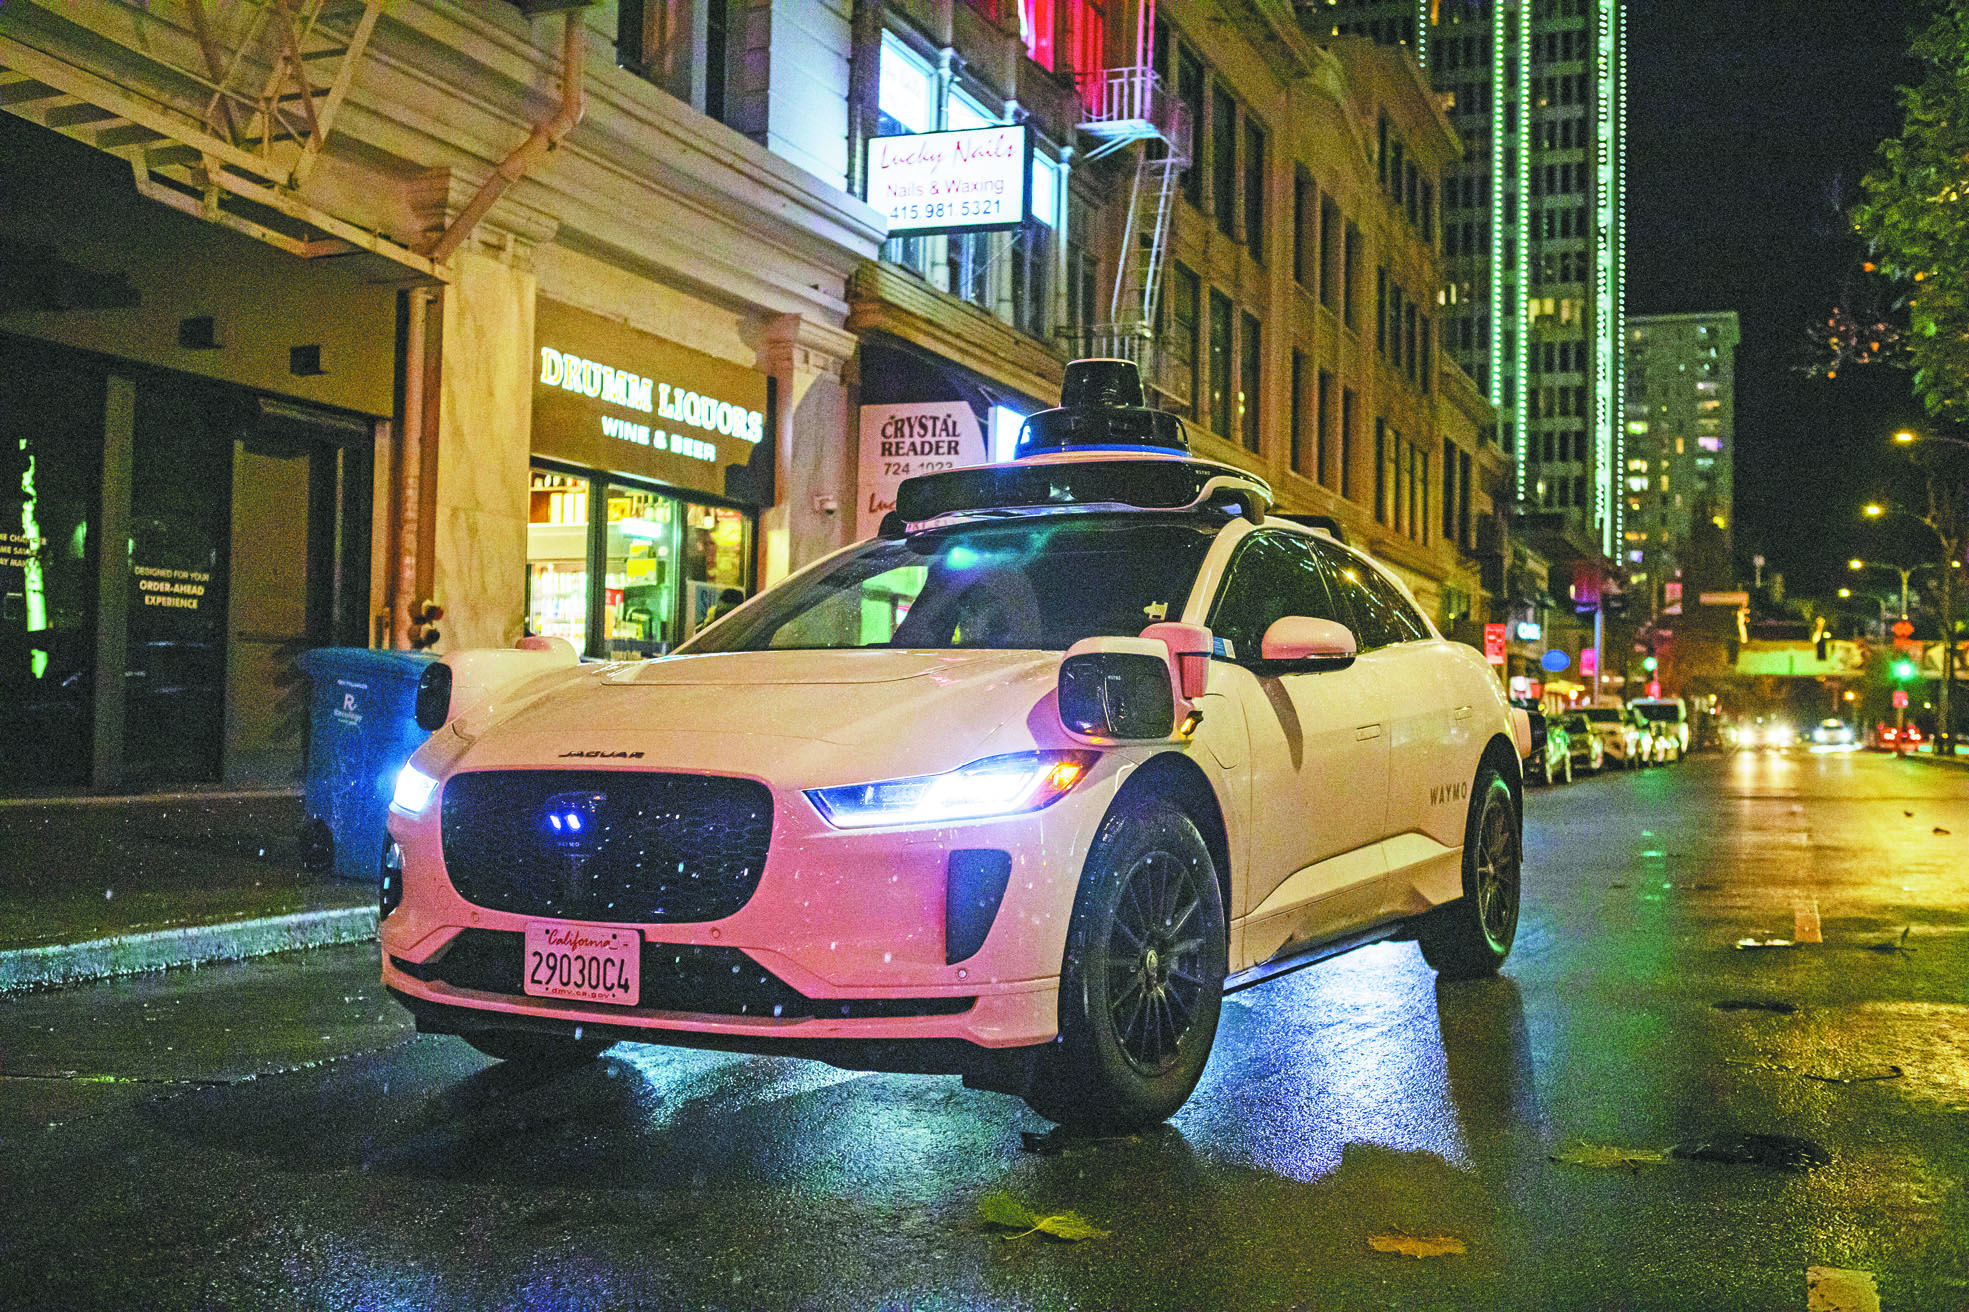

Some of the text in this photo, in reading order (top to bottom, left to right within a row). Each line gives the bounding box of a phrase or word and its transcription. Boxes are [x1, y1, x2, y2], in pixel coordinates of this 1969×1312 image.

[881, 133, 1014, 174] Lucky Nails
[887, 178, 1005, 197] Nails & Waxing
[541, 346, 763, 443] DRUMM LIQUORS
[881, 414, 961, 439] CRYSTAL
[601, 415, 717, 462] WINE & BEER
[880, 439, 960, 457] READER
[884, 462, 910, 476] 724
[134, 566, 210, 582] DESIGNED FOR YOUR
[139, 580, 205, 596] ORDER-AHEAD
[144, 594, 199, 610] EXPERIENCE
[558, 750, 645, 758] JAGUAR
[1430, 781, 1468, 806] WAYMO
[548, 928, 612, 952] California
[530, 950, 630, 994] 29030C4
[551, 988, 610, 999] dmv.ca.gov
